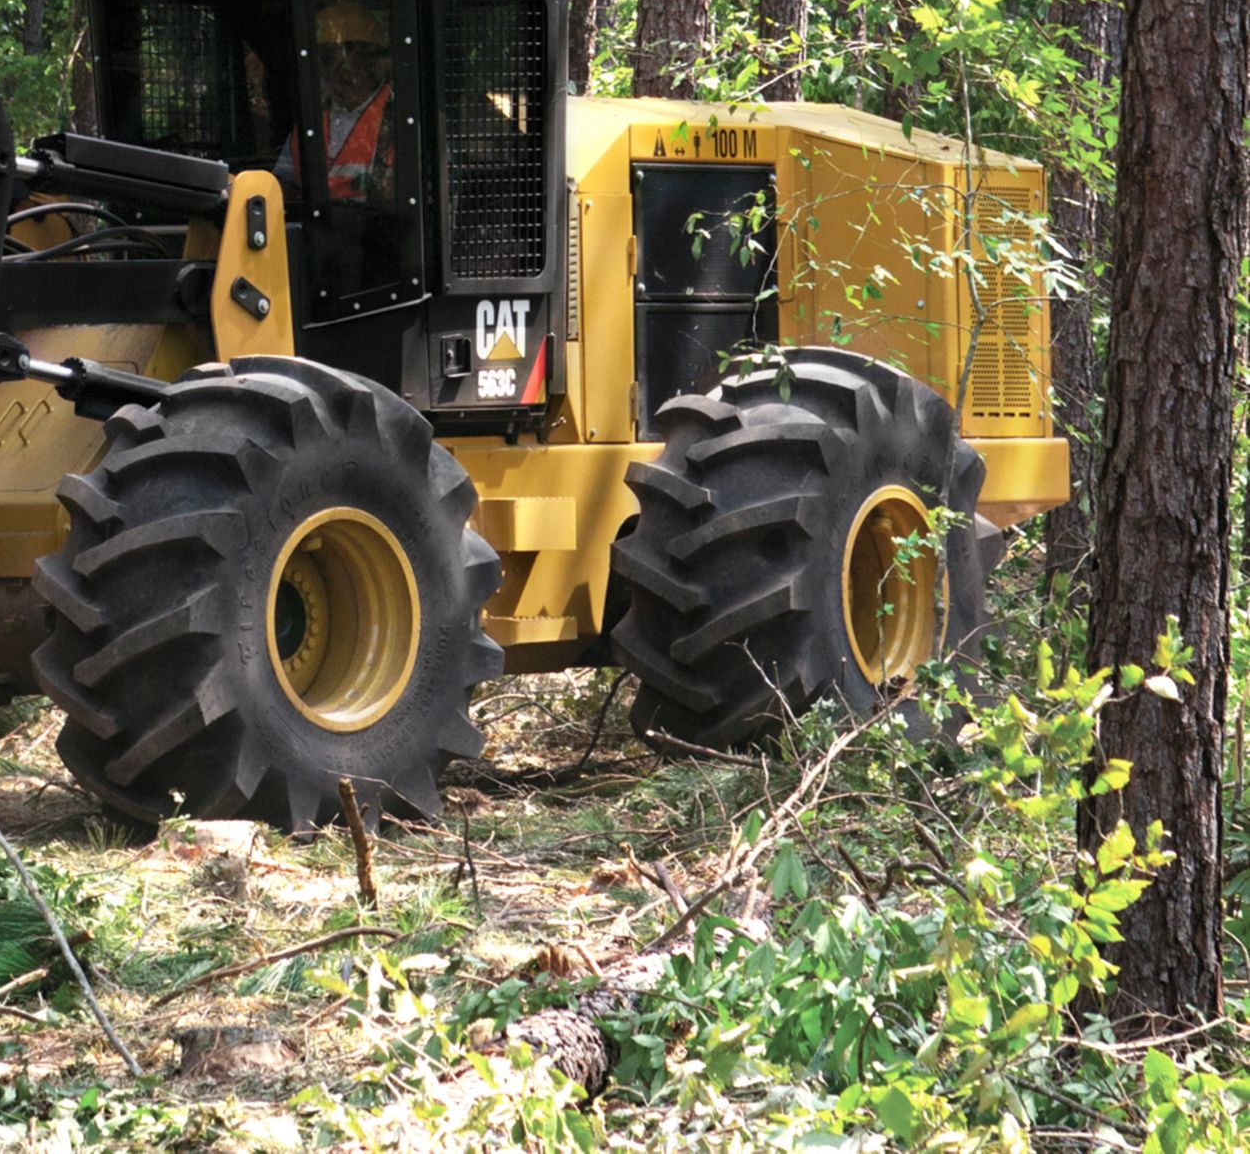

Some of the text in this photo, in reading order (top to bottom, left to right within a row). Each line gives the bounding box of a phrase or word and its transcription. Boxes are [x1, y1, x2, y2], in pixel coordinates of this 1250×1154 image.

[712, 129, 757, 158] 100 M
[476, 299, 530, 360] CAT
[477, 368, 517, 398] 563C
